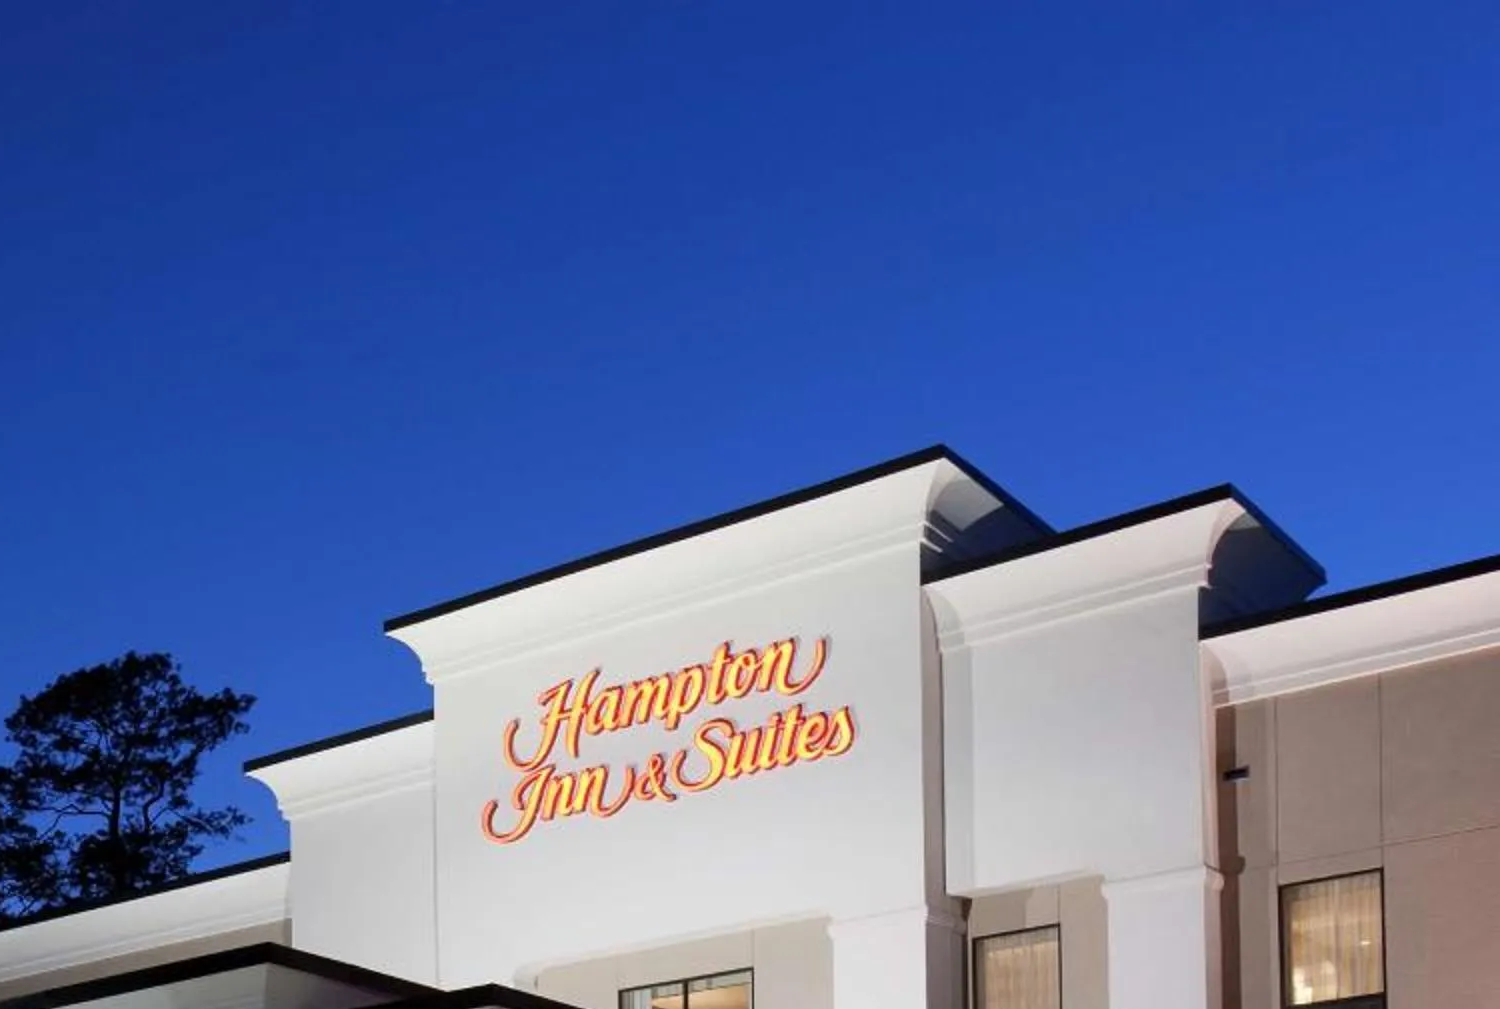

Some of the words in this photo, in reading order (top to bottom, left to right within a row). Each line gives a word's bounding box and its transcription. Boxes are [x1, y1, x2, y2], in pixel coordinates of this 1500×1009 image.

[504, 635, 831, 772] Hampton
[481, 764, 636, 844] Inn
[633, 752, 677, 802] &
[670, 704, 857, 792] Suites
